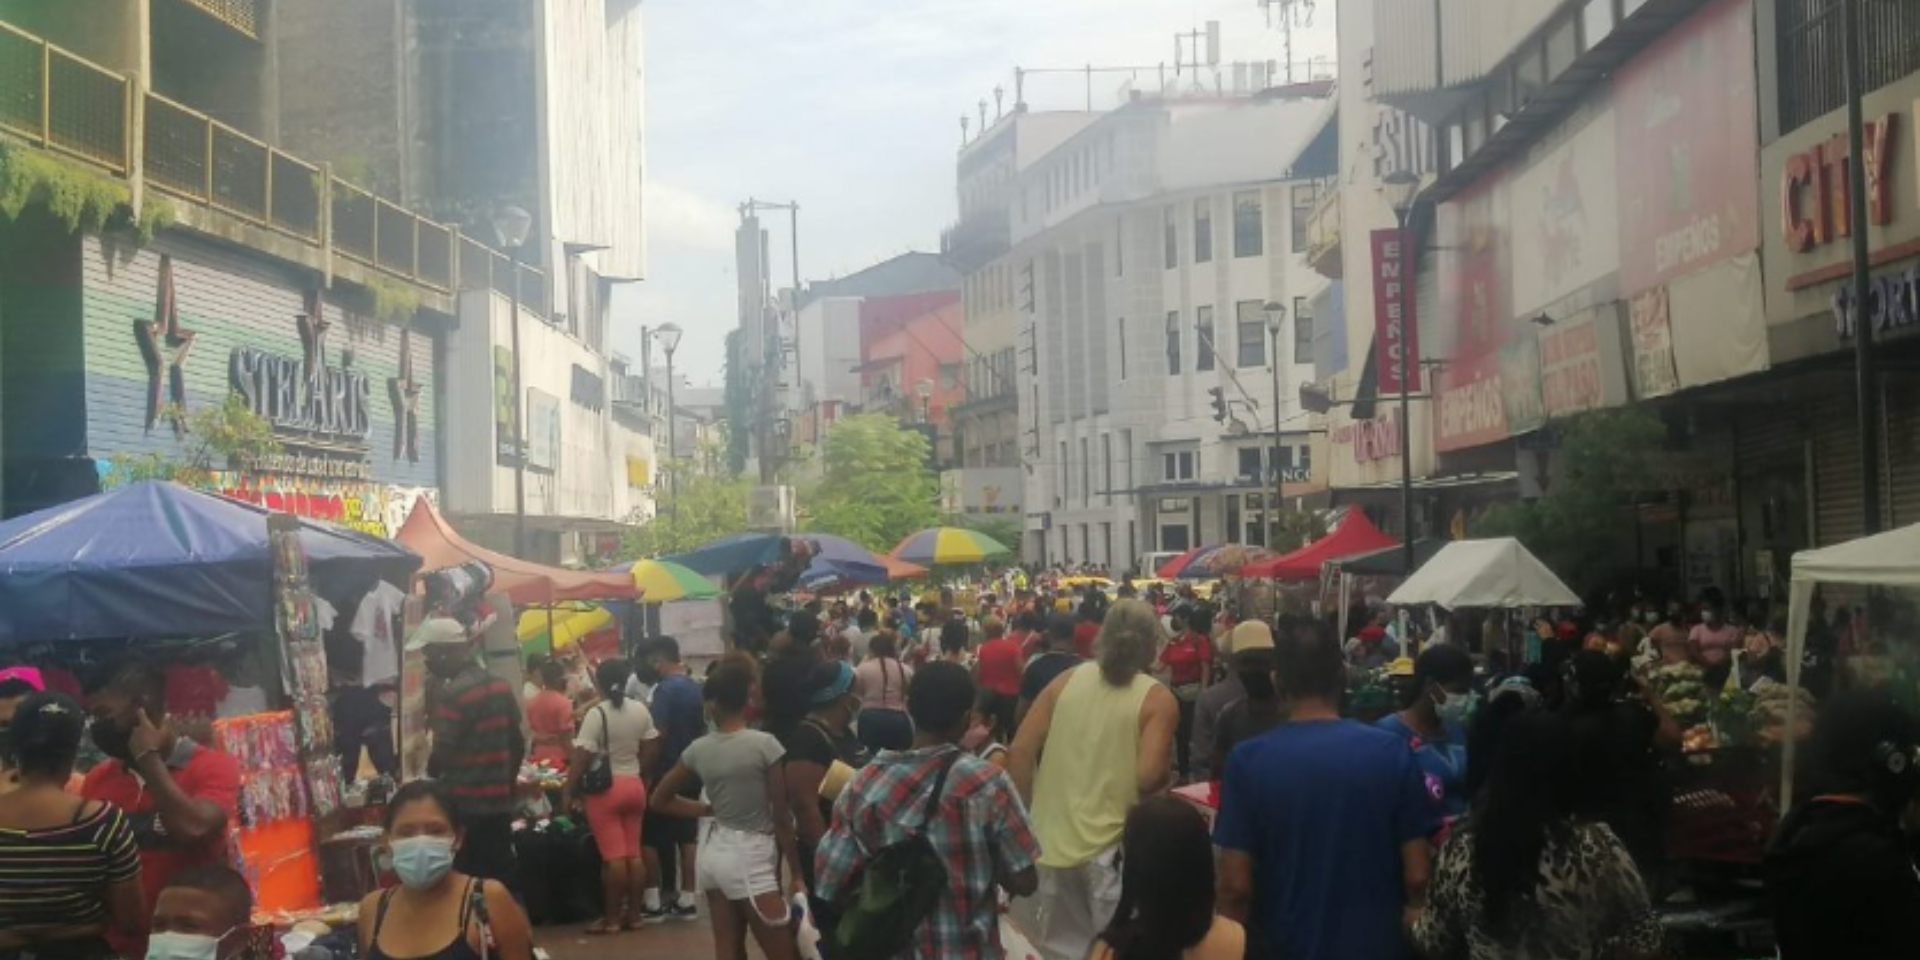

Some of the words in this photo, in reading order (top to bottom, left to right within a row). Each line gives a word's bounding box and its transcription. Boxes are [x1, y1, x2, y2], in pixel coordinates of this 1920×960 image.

[1781, 112, 1901, 253] CITY
[1655, 212, 1719, 273] EMPEÑOS
[229, 338, 372, 440] STELARIS
[1441, 370, 1503, 438] EMPEÑOS
